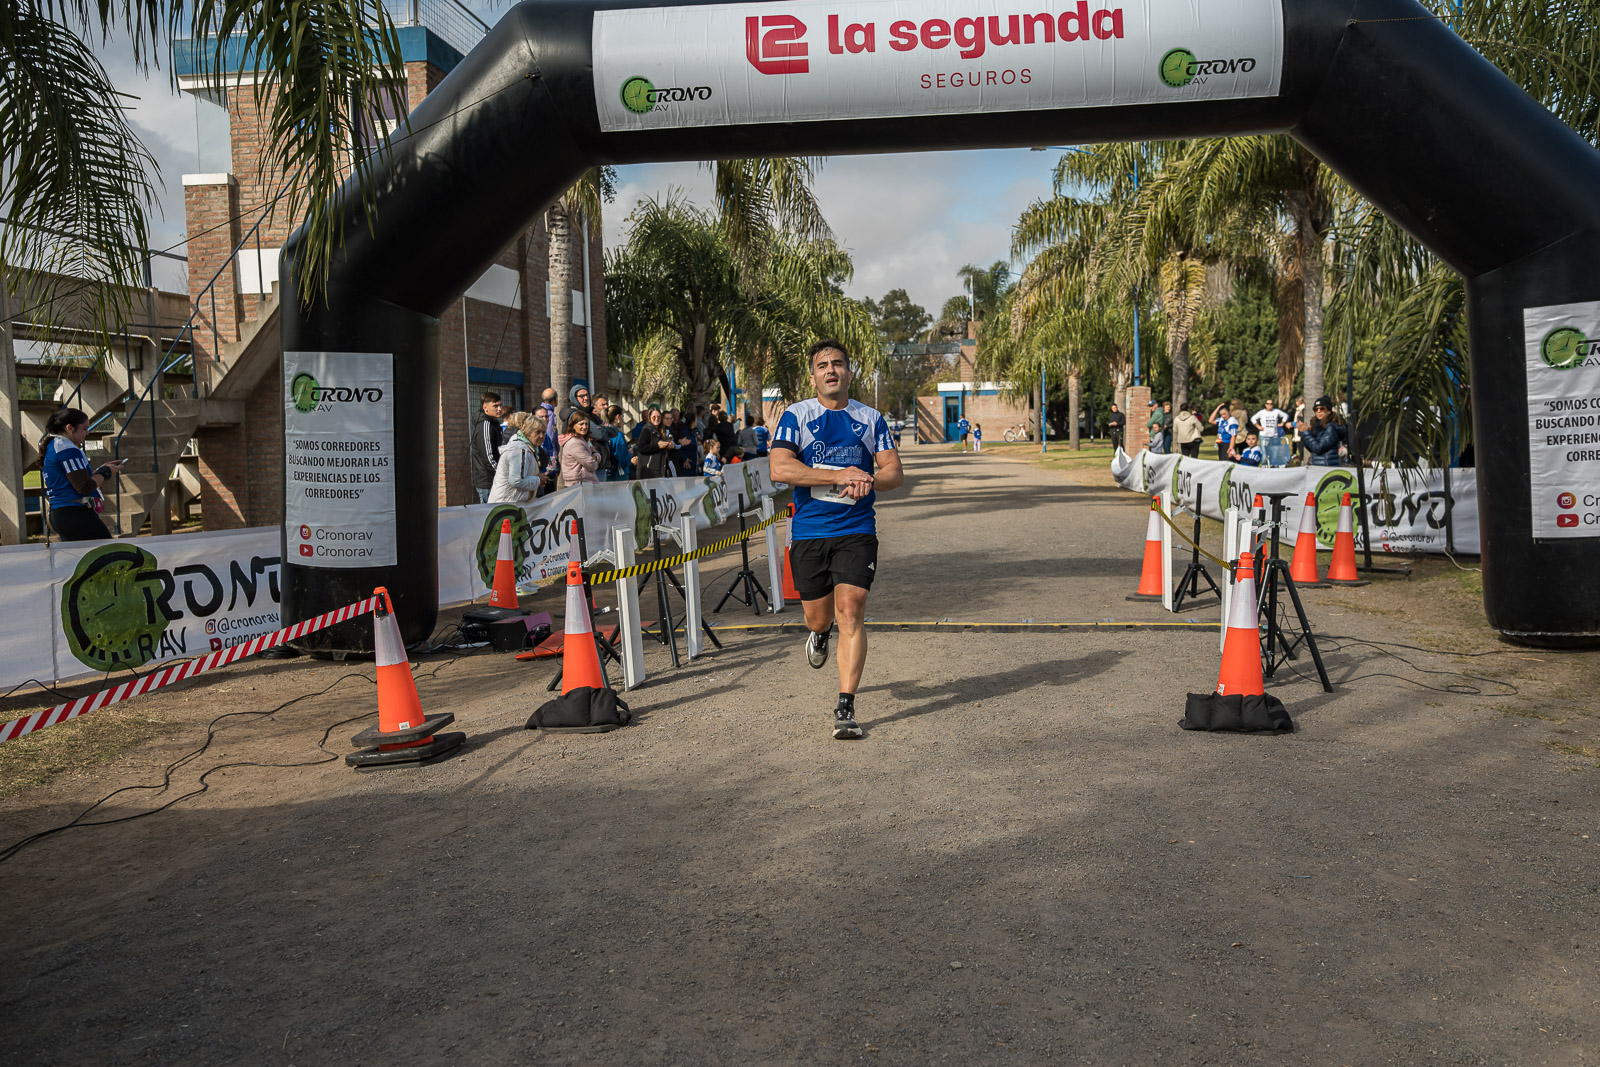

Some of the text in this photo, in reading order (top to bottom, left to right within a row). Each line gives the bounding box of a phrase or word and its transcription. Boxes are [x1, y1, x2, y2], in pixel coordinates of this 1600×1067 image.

[828, 1, 1124, 59] la segunda
[1185, 57, 1256, 77] CRONO
[920, 68, 1032, 89] SEGUROS
[1183, 76, 1209, 86] RAV
[646, 86, 712, 103] CRONO
[645, 104, 669, 113] RAV
[310, 387, 383, 403] CRONO
[309, 403, 333, 412] RAV
[1535, 417, 1594, 430] BUSCANDO
[321, 440, 381, 452] CORREDORES
[1546, 433, 1600, 446] EXPERIEN
[811, 440, 826, 464] 3
[288, 454, 389, 467] BUSCANDO MEJORAR LAS
[294, 472, 381, 483] EXPERIENCIAS DE LOS
[316, 528, 373, 540] Cronorav
[316, 545, 373, 557] Cronorav
[217, 612, 280, 634] @cronorav
[138, 626, 186, 662] RAV
